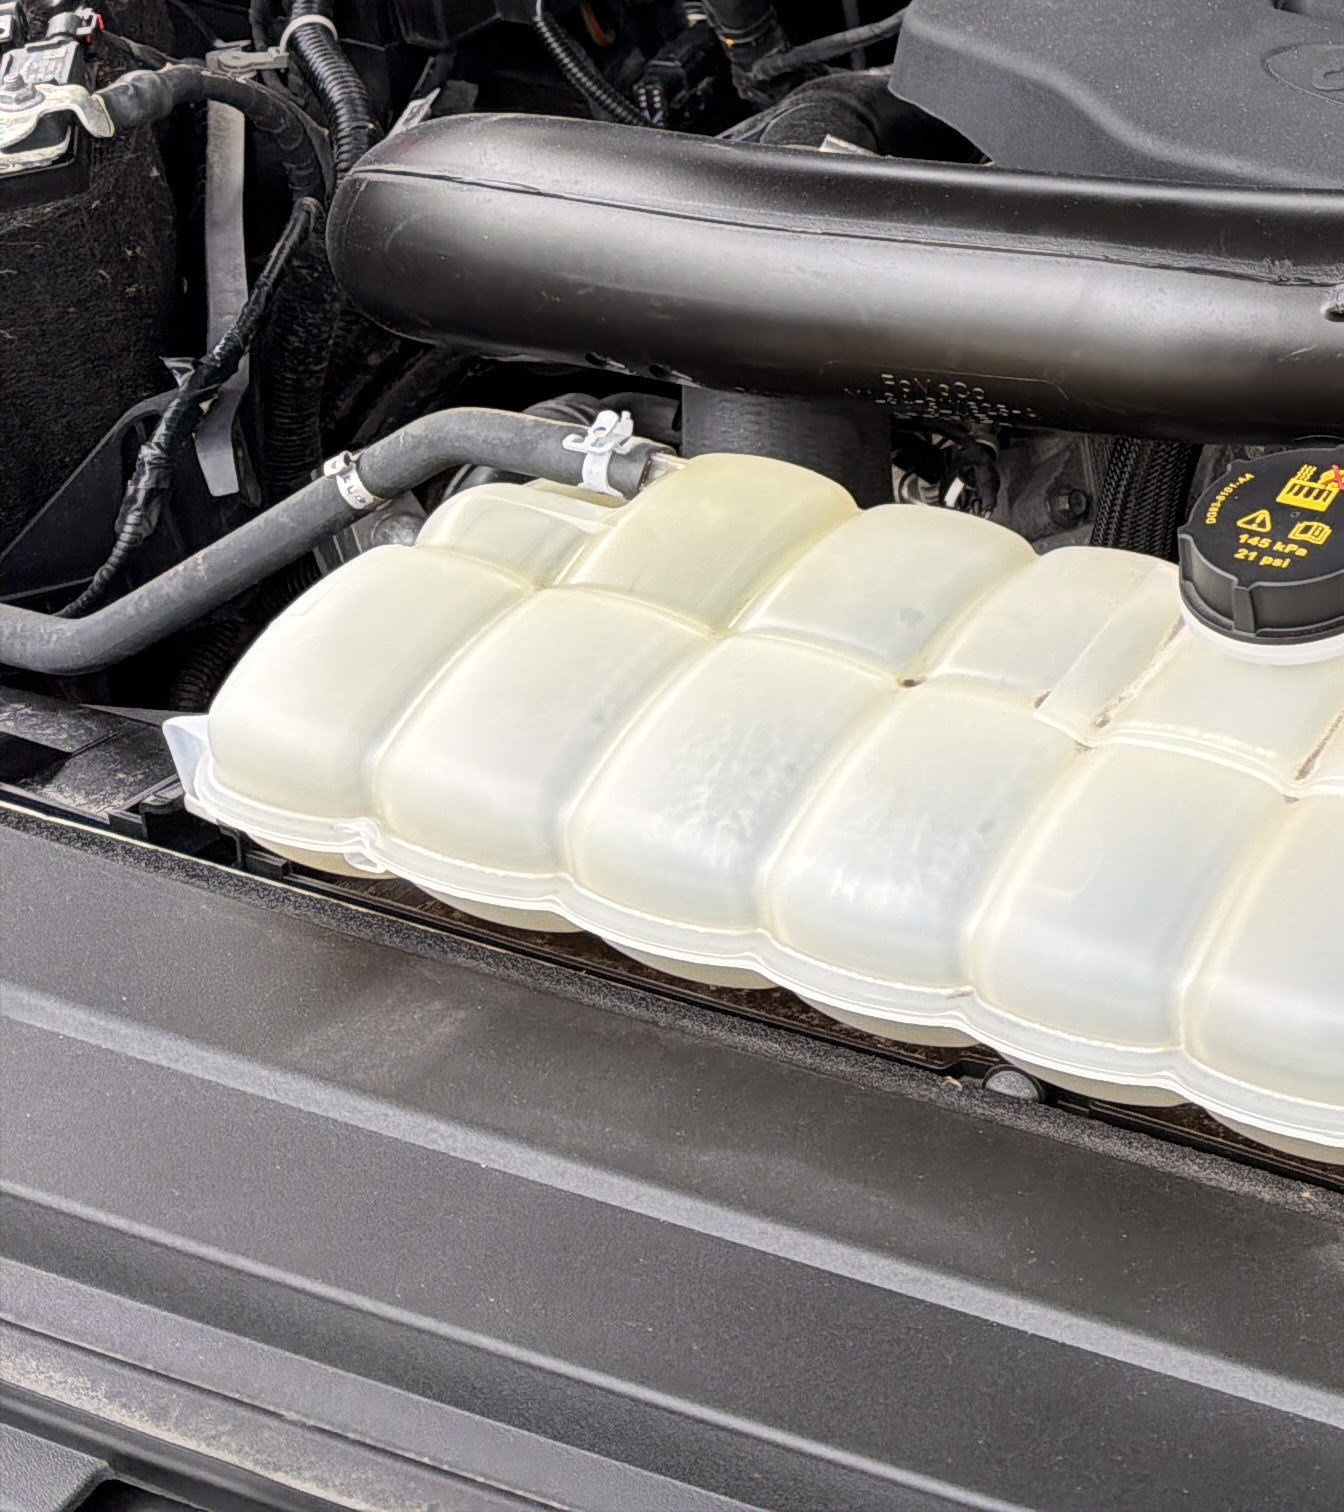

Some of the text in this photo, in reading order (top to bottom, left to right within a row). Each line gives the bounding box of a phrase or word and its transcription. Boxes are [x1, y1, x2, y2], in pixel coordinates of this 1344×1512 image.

[1238, 534, 1308, 557] 145 kPa
[1233, 549, 1292, 569] 21 psi
